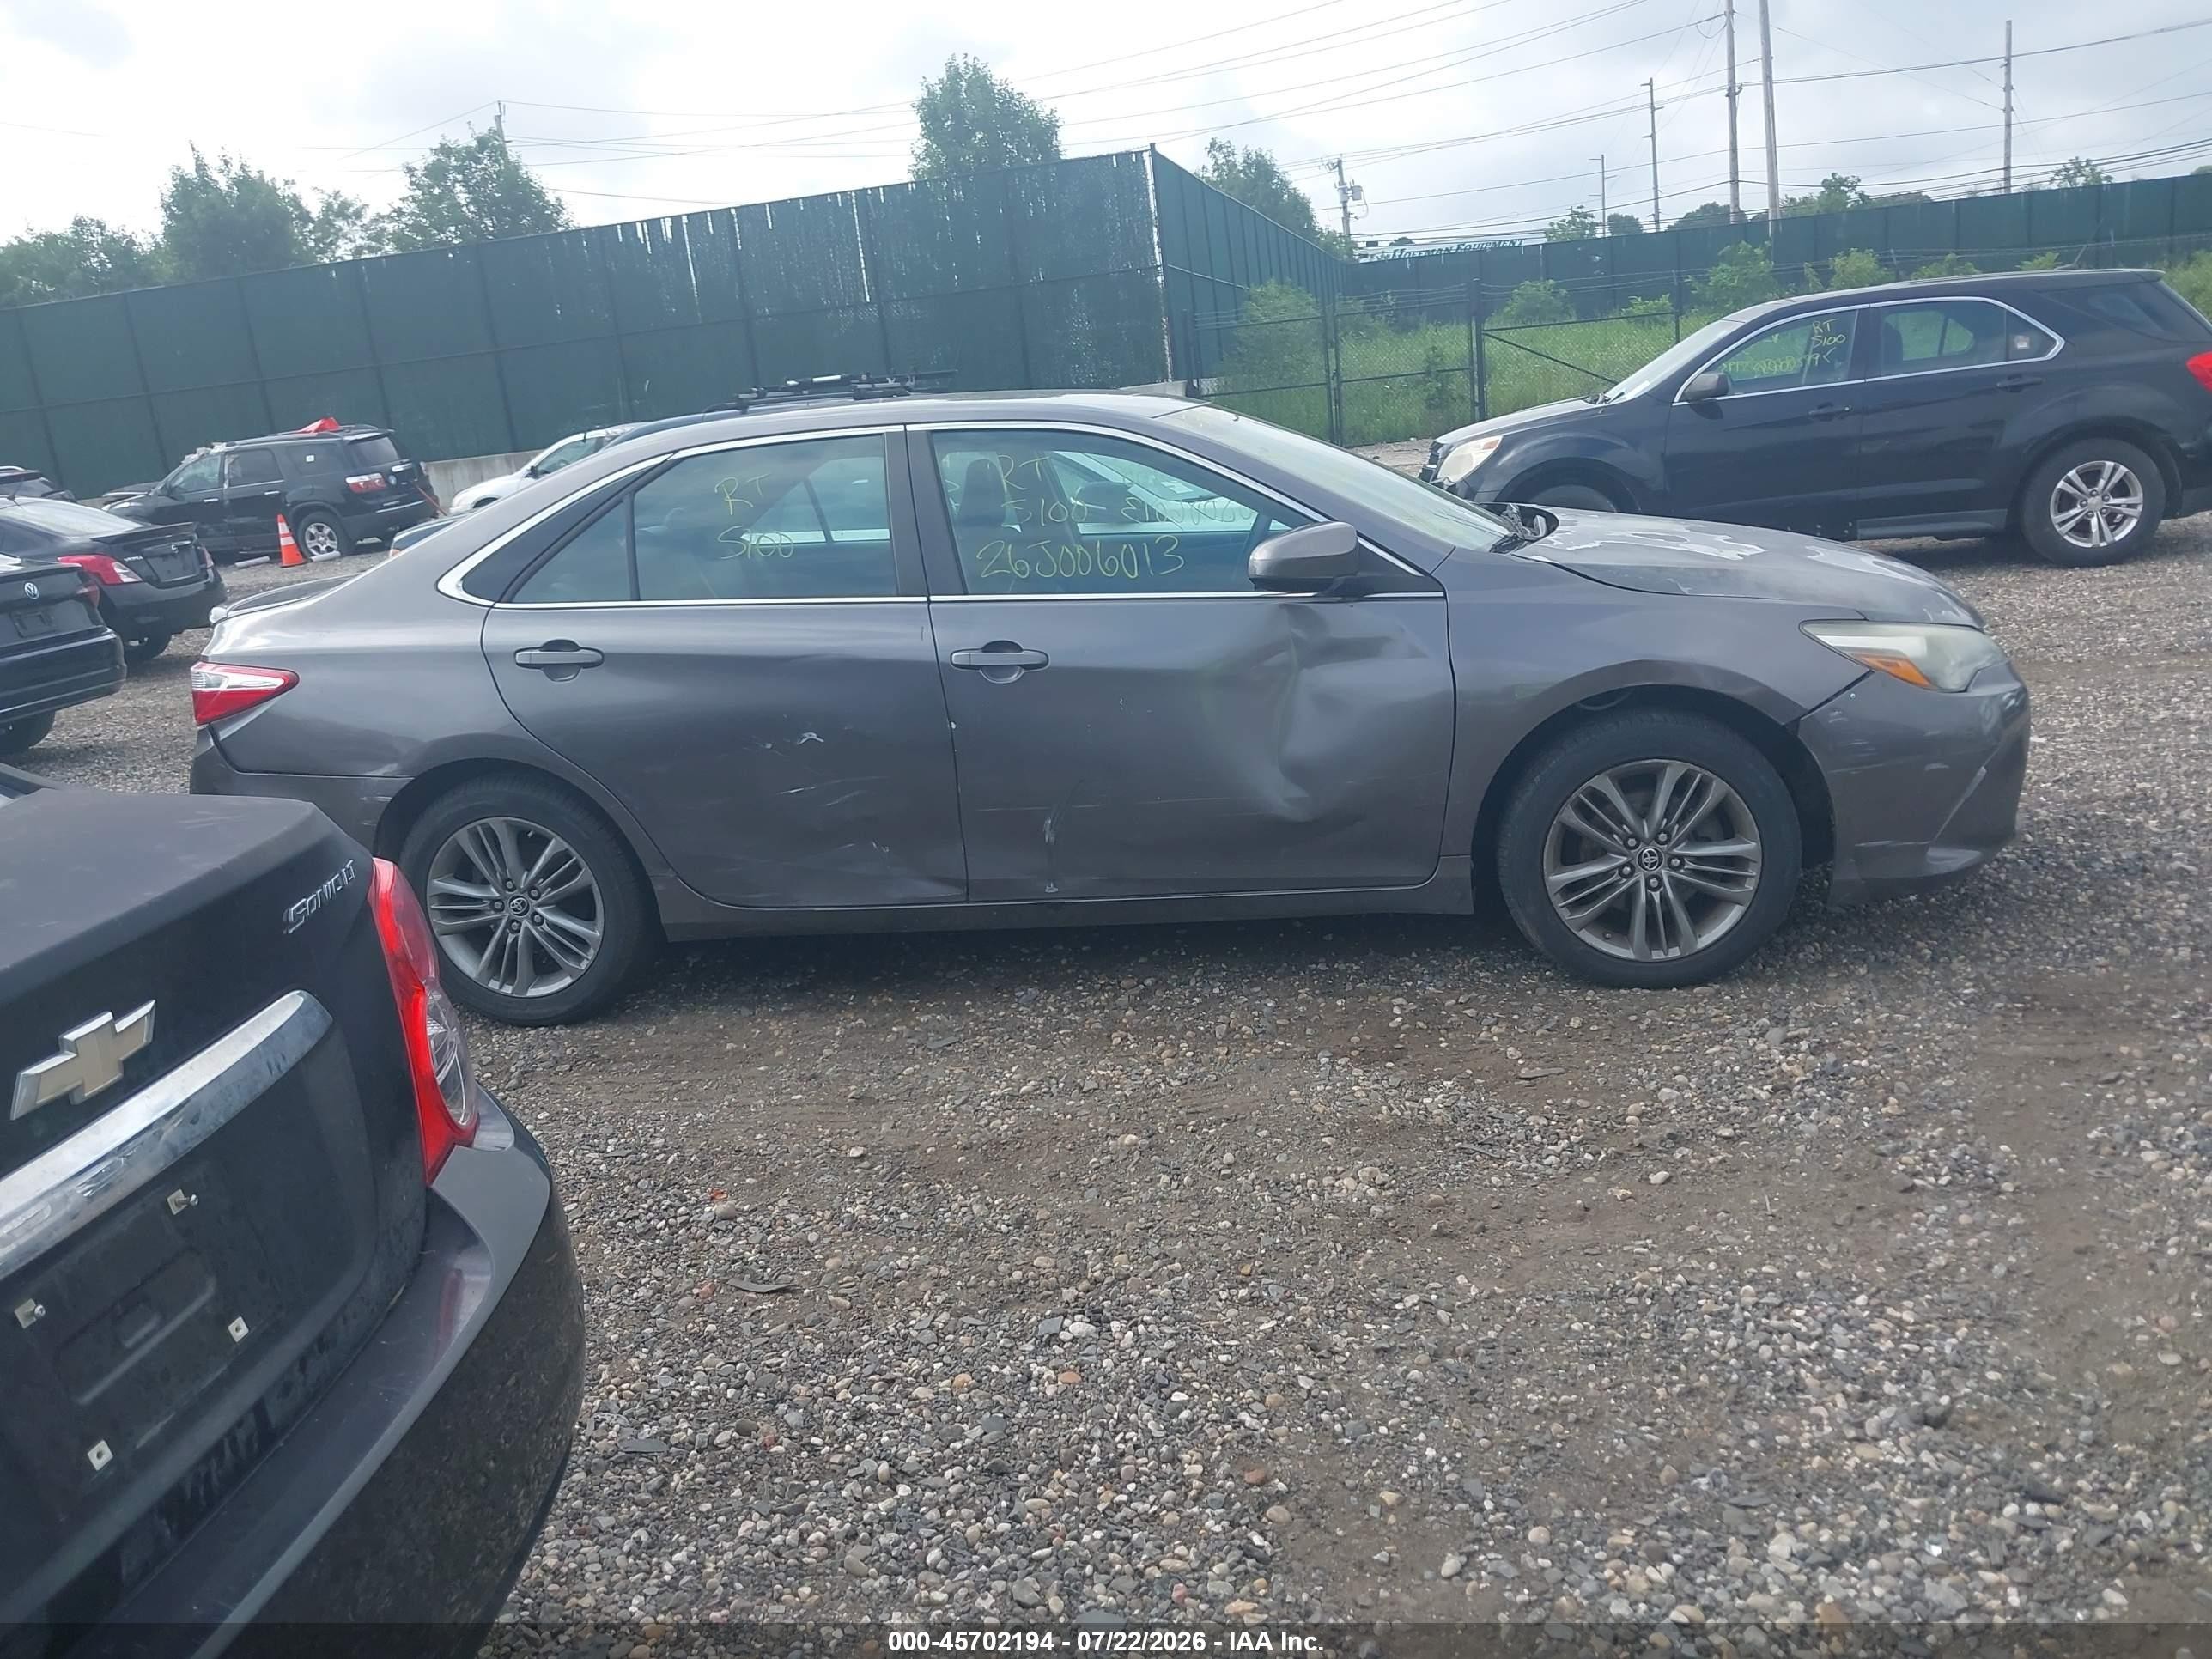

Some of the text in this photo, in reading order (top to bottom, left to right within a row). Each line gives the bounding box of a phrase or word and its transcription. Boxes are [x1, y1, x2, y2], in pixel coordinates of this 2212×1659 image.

[1812, 319, 1841, 333] RT
[997, 454, 1046, 491] RT
[714, 473, 770, 515] RT
[975, 534, 1185, 578] 26J006013
